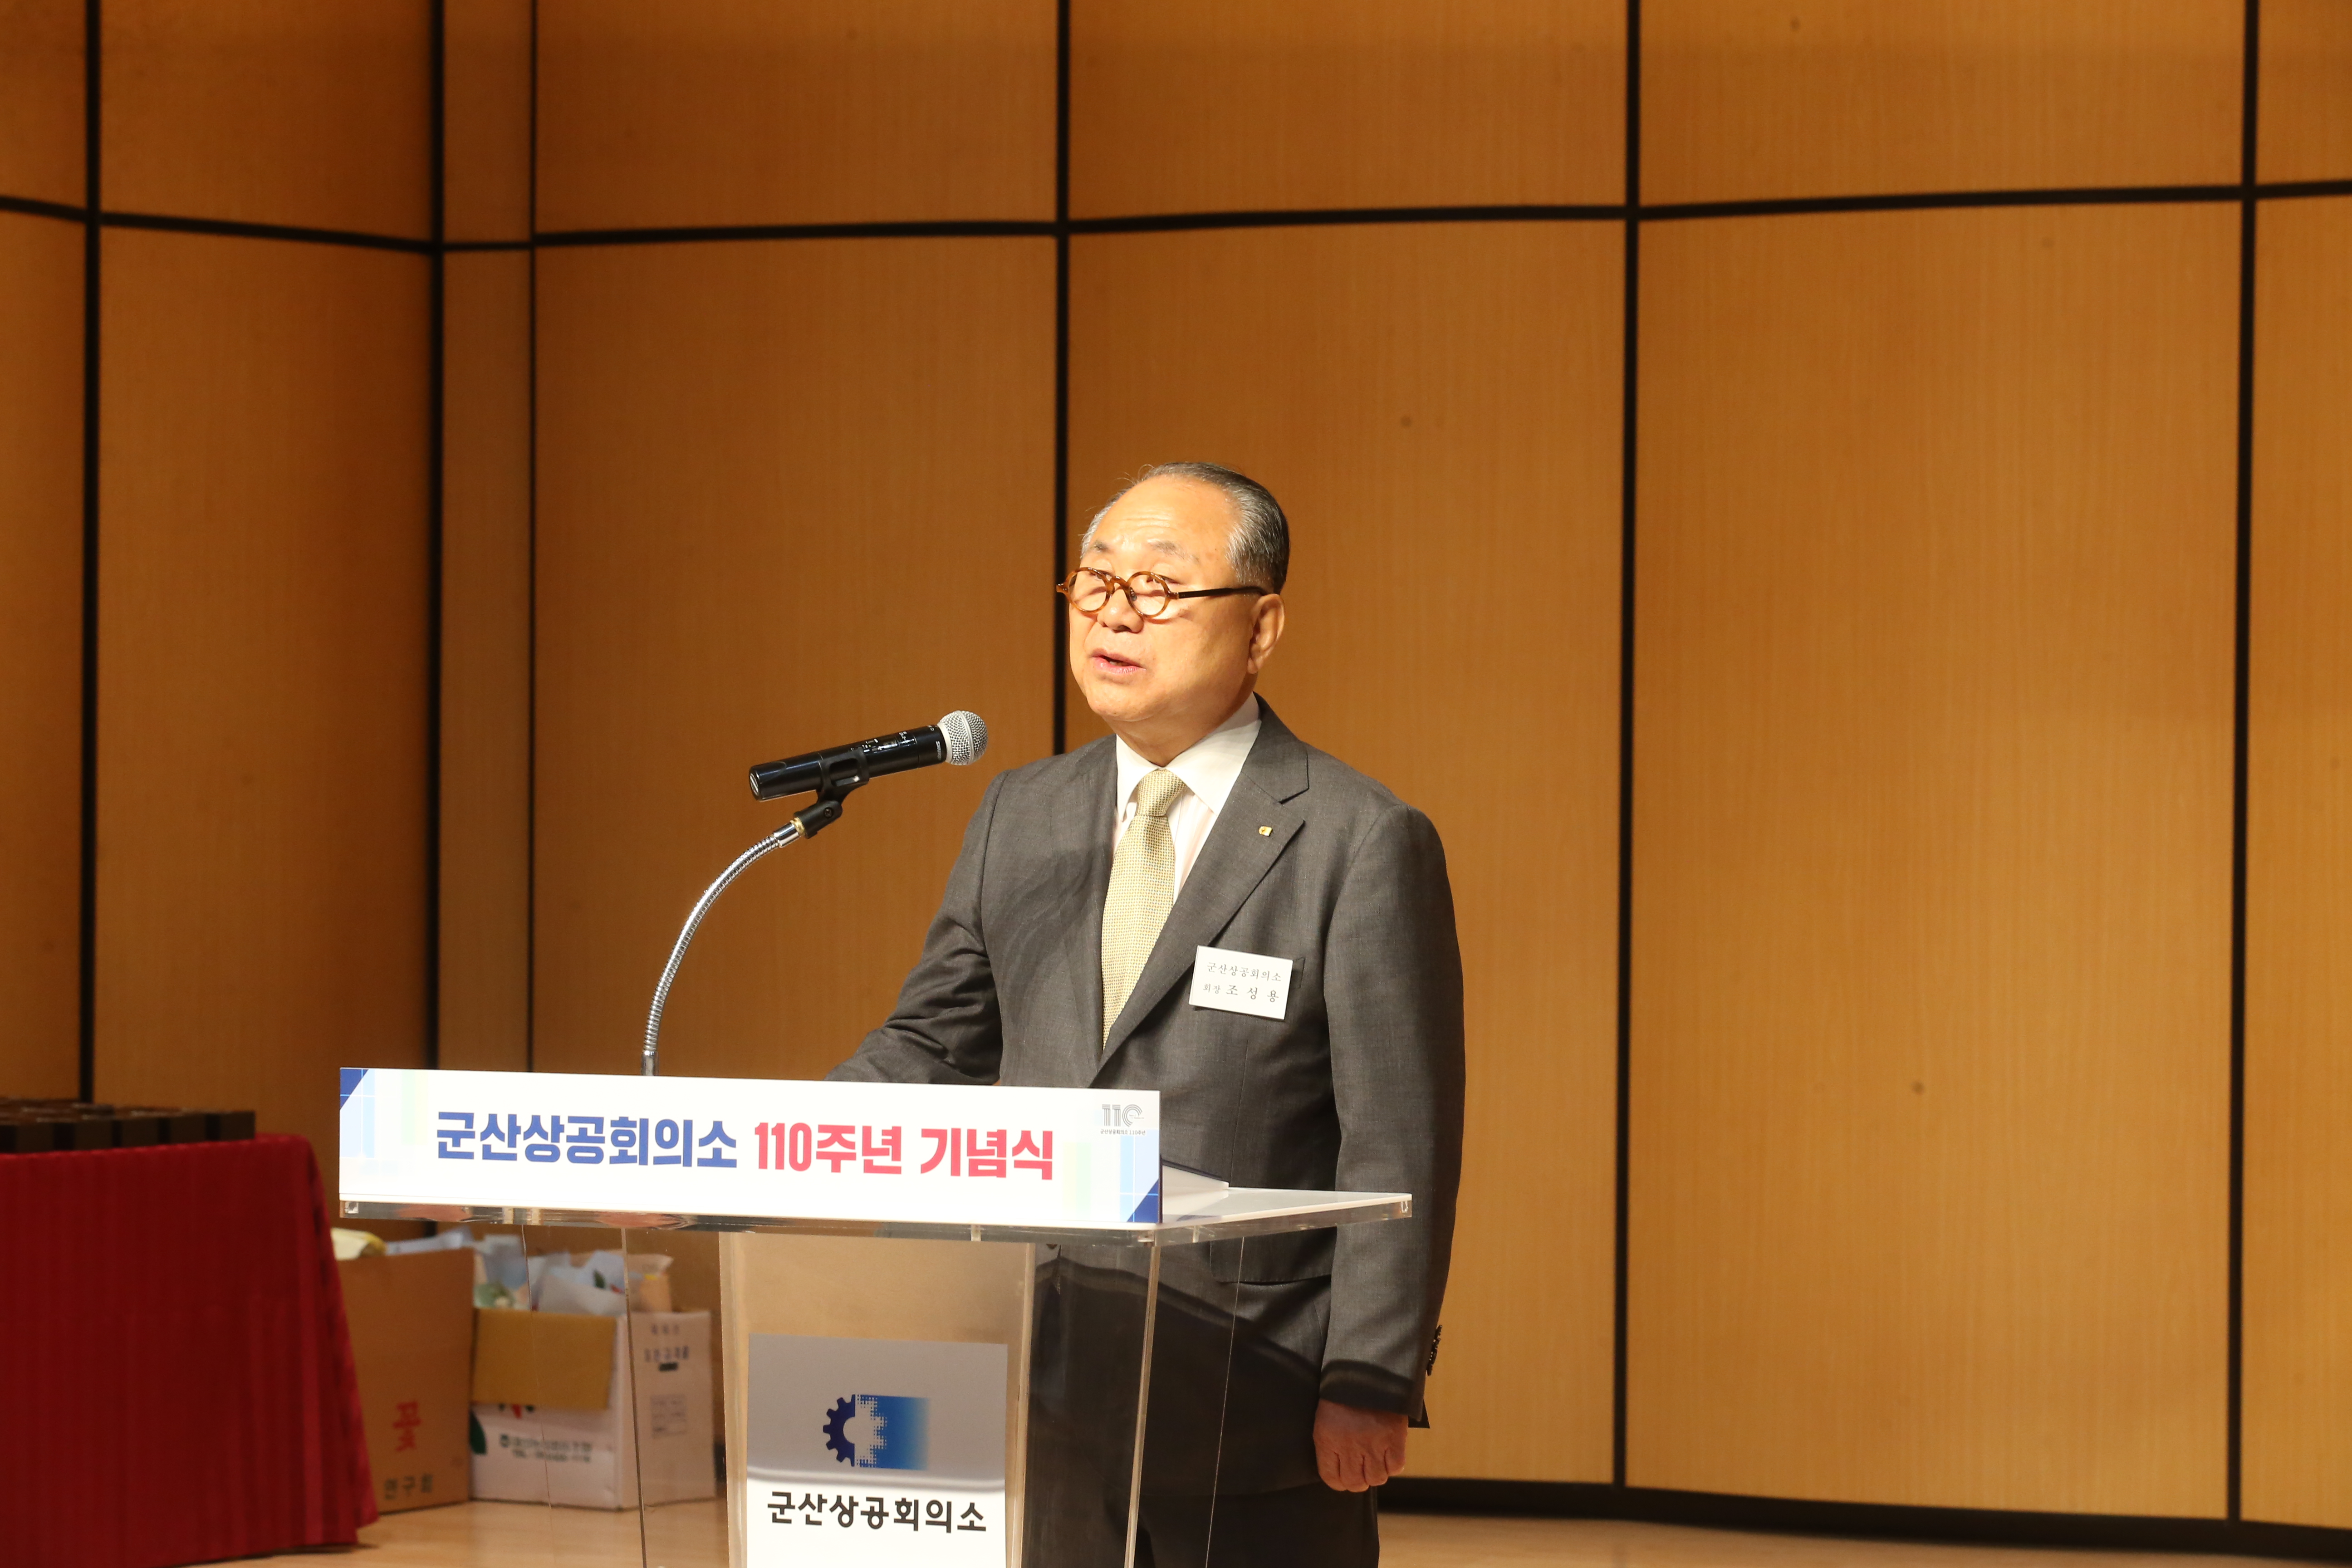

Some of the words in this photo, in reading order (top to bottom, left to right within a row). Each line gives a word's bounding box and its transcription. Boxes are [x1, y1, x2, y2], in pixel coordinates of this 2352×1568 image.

[1207, 962, 1281, 981] 군산상공회의소
[1203, 984, 1220, 994] 회장
[437, 1112, 737, 1168] 군산상공회의소
[755, 1122, 902, 1175] 110주년
[921, 1127, 1053, 1180] 기념식
[768, 1491, 986, 1534] 군산상공회의소
